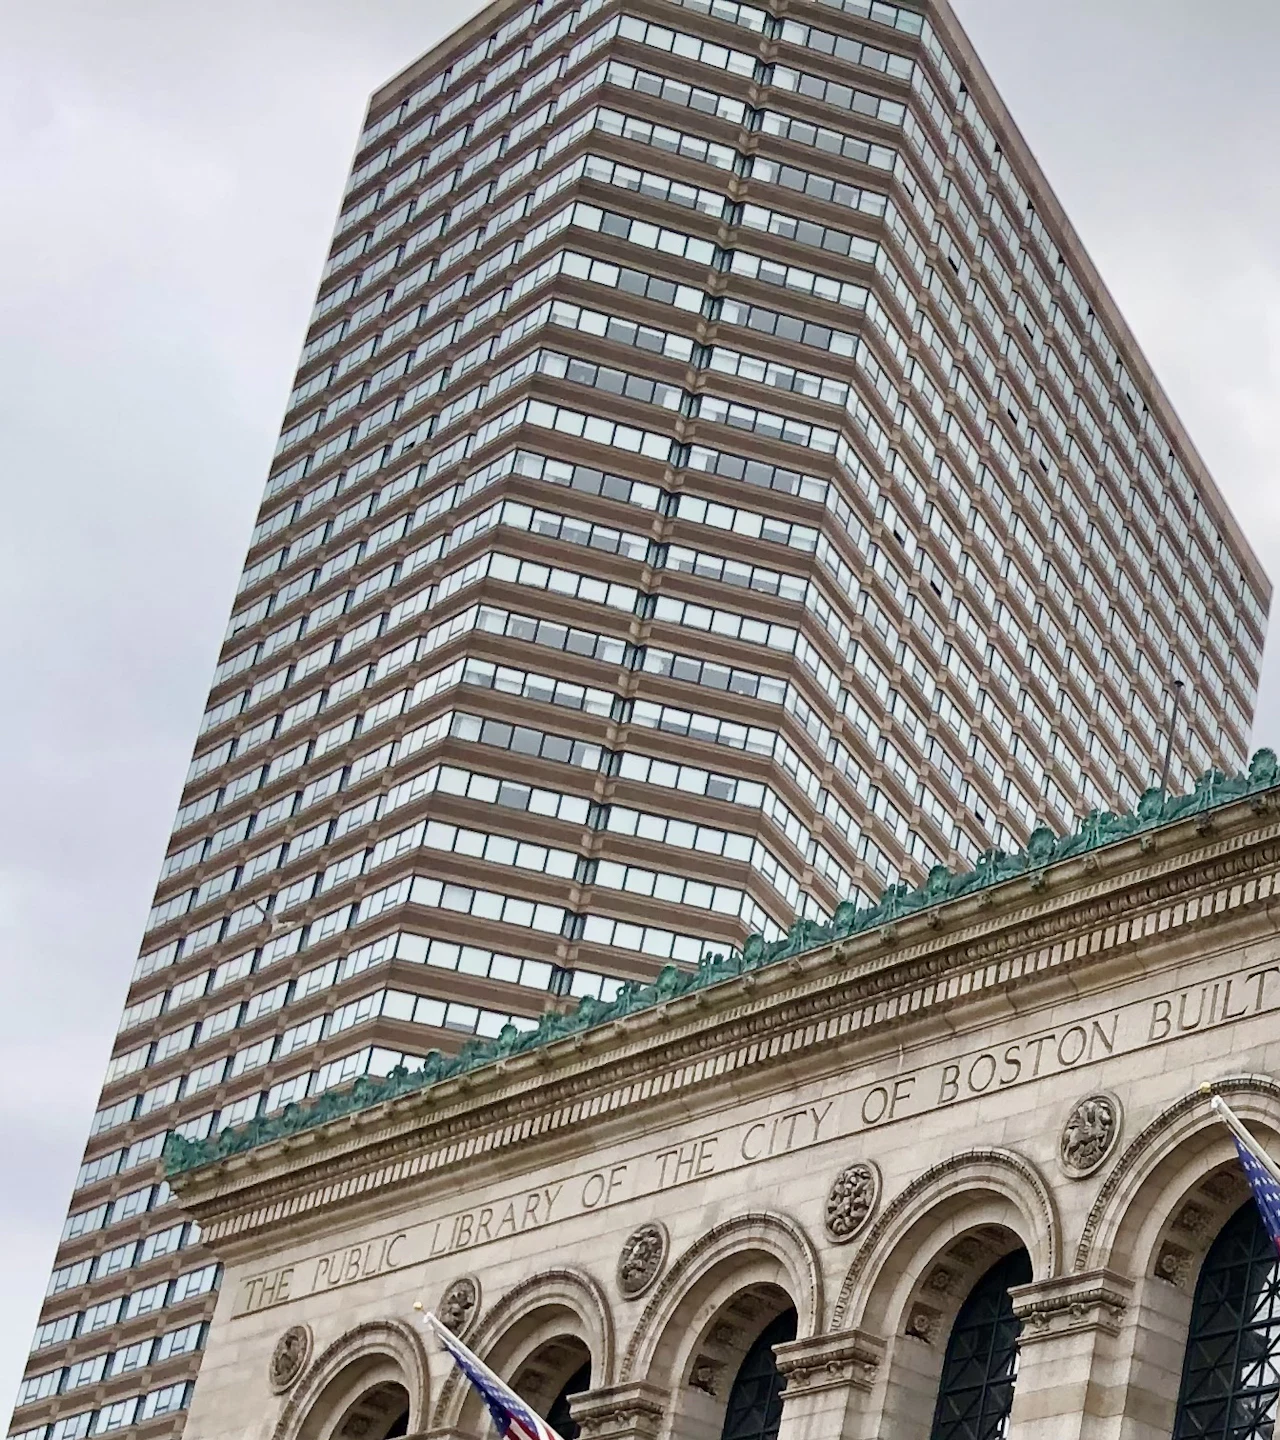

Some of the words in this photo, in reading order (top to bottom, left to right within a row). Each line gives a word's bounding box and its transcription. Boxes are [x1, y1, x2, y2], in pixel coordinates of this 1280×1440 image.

[246, 1269, 294, 1311] THE
[312, 1235, 407, 1291] PUBLIC
[429, 1185, 563, 1256] LIBRARY
[581, 1165, 627, 1208] OF
[656, 1138, 718, 1188] THE
[741, 1102, 833, 1160] CITY
[862, 1078, 917, 1125] OF
[938, 1015, 1119, 1104] BOSTON
[1148, 966, 1280, 1042] BUILT
